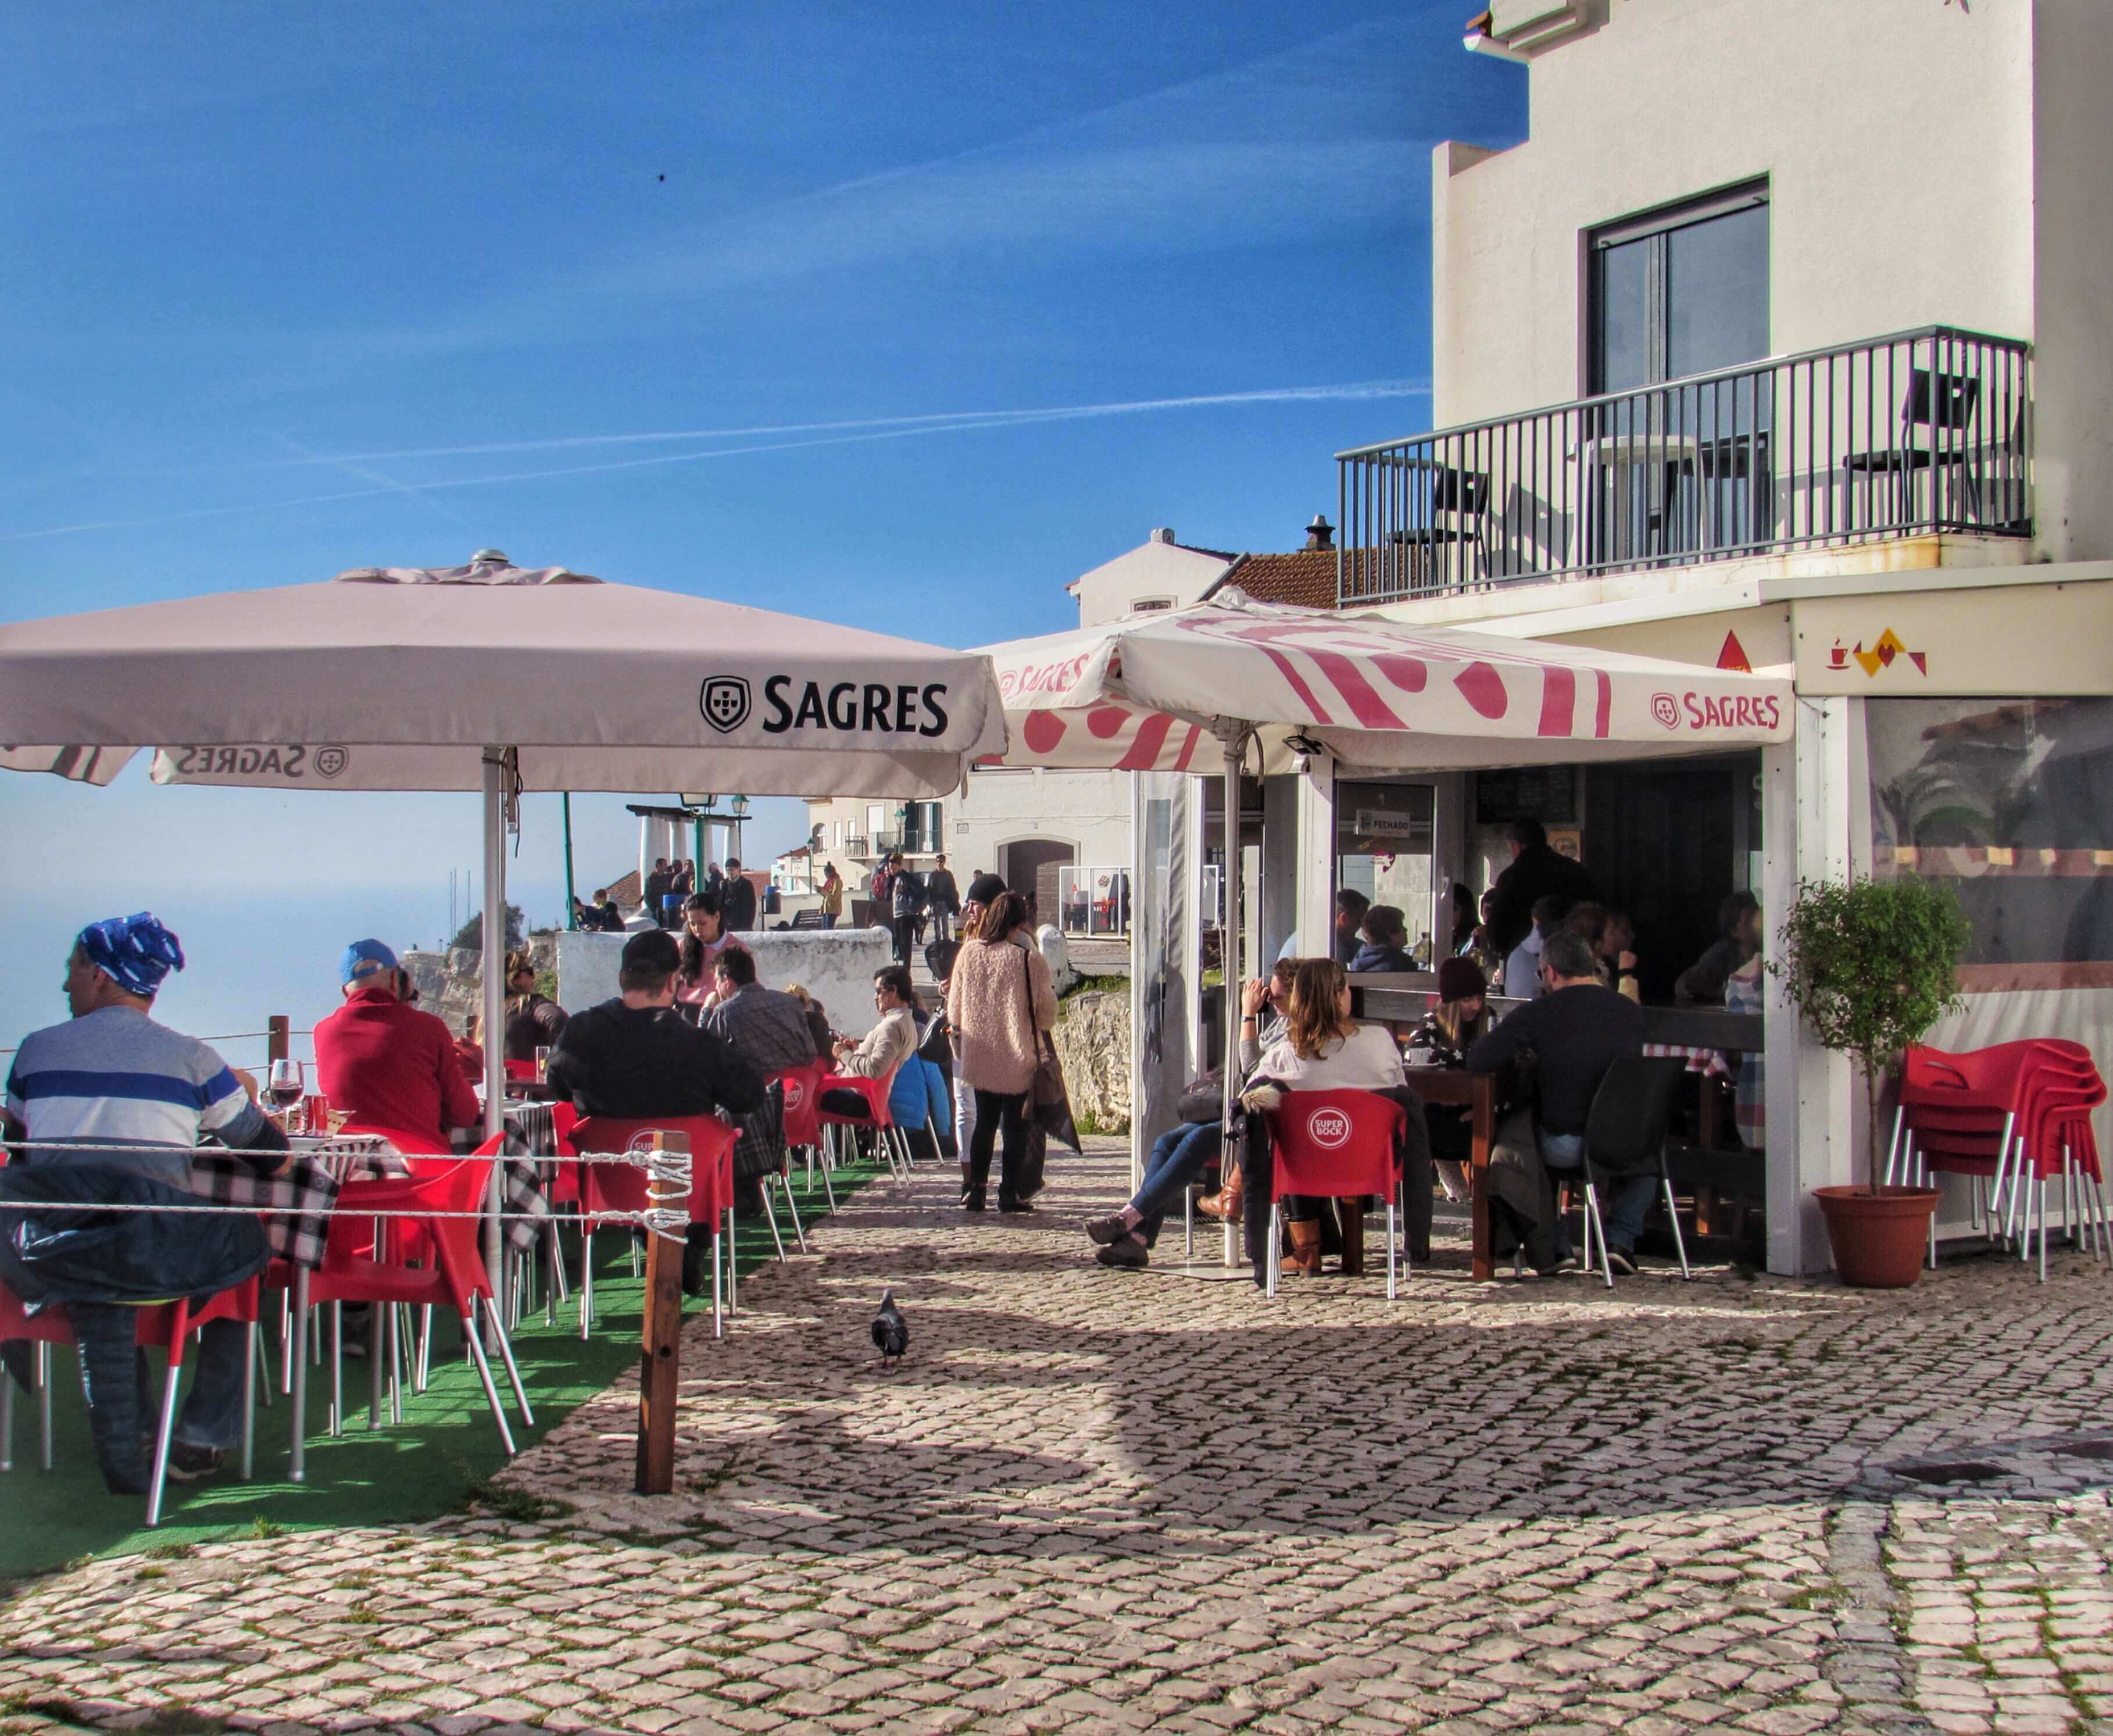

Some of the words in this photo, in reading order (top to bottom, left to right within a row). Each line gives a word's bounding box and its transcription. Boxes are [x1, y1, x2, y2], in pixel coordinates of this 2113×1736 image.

[762, 674, 949, 737] SAGRES
[1683, 691, 1779, 730] SAGRES
[1374, 820, 1408, 829] FECHADO
[1315, 1119, 1343, 1128] SUPER
[1316, 1127, 1342, 1135] BOCK
[635, 1142, 654, 1151] SUP
